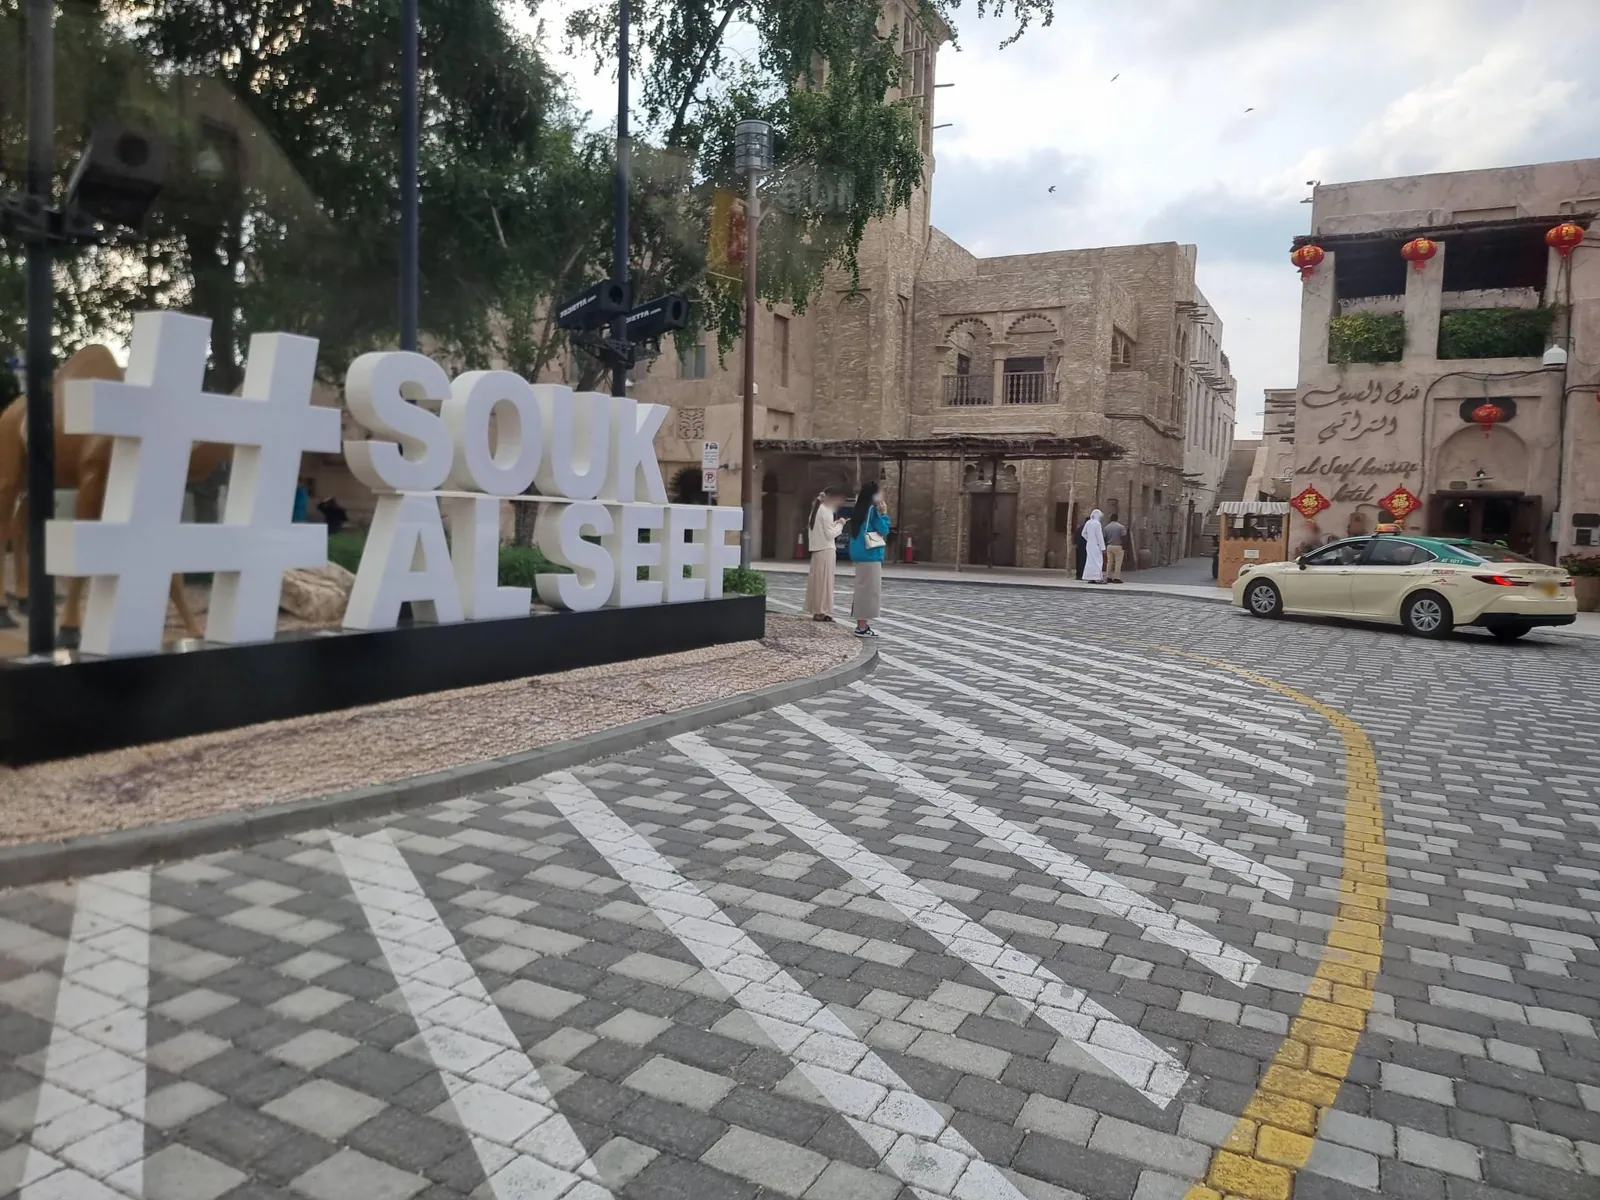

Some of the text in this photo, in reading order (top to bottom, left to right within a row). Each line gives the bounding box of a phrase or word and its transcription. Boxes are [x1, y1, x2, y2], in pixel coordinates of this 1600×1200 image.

[344, 351, 671, 505] SOUK
[1302, 379, 1382, 409] السيف
[342, 493, 743, 630] AL SEEF
